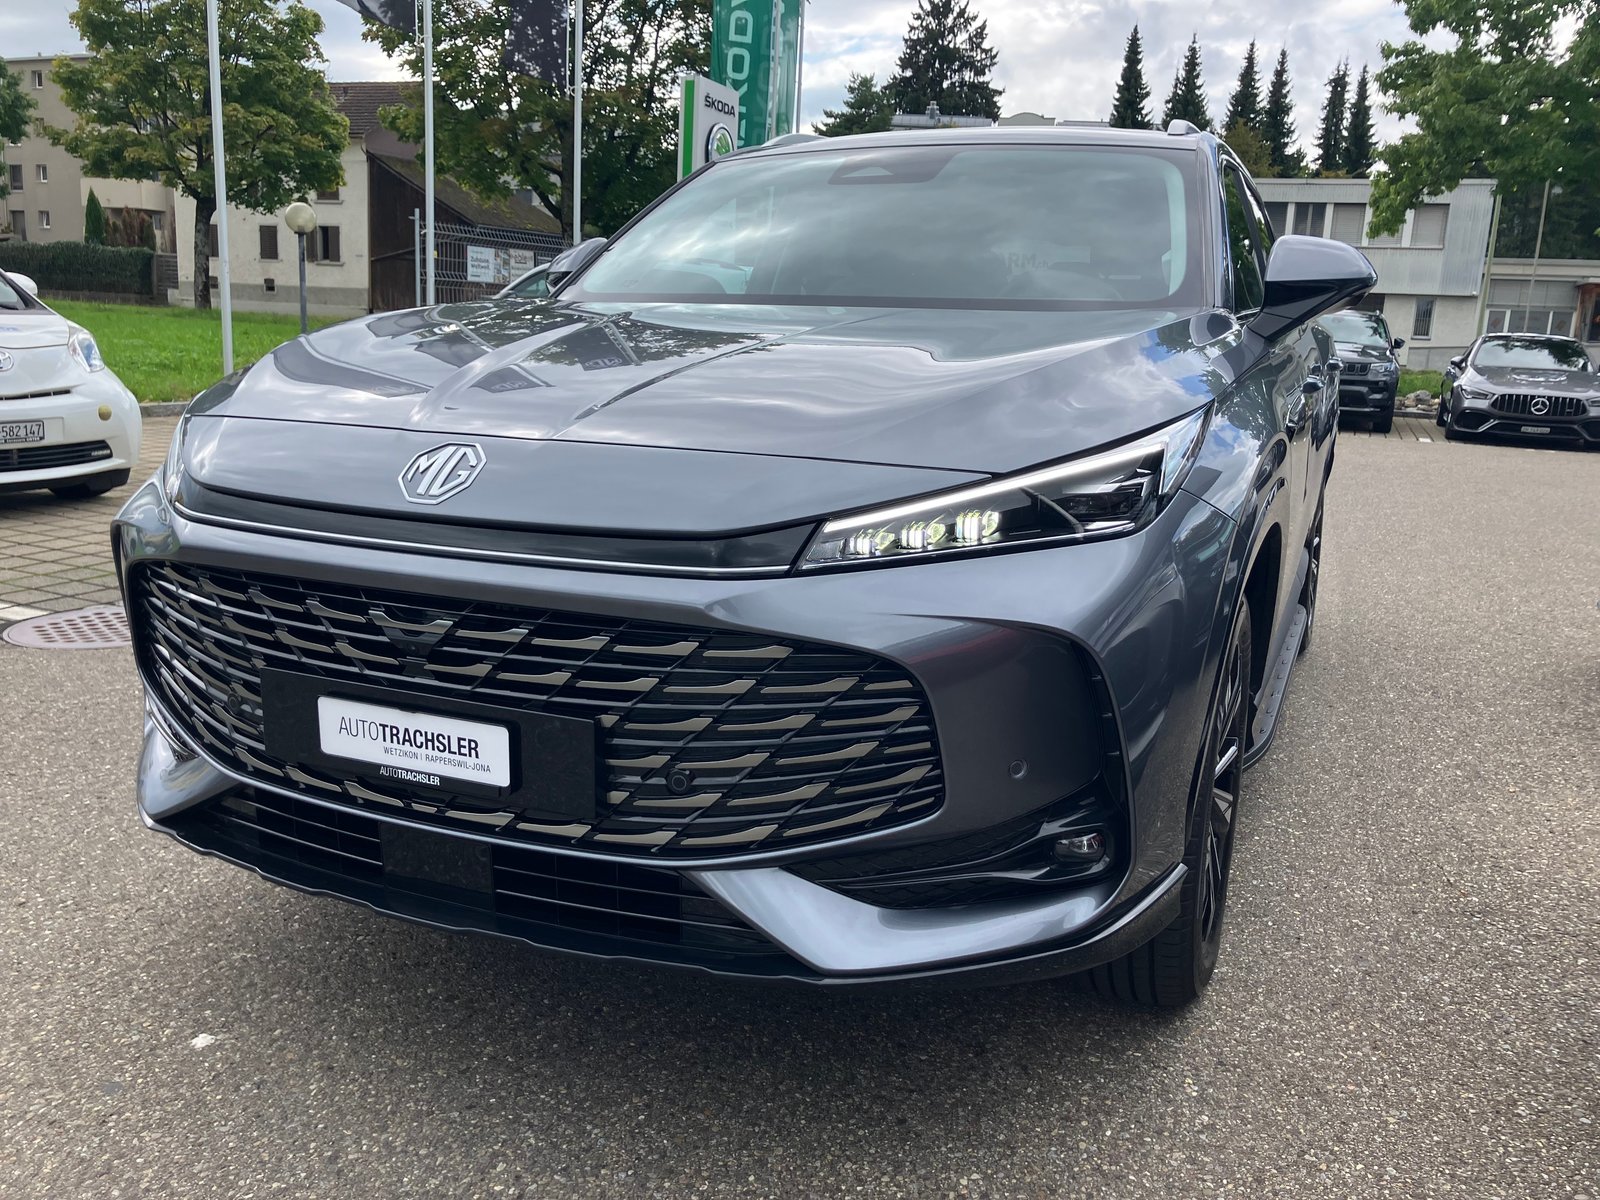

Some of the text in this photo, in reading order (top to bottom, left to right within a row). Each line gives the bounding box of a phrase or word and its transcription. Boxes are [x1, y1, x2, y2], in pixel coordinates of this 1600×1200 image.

[704, 92, 736, 118] ŠKODA
[407, 445, 479, 498] MG
[338, 716, 480, 759] AUTOTRACHSLER
[383, 746, 491, 773] WETZIKON RAPPERSWIL-JONA
[379, 765, 440, 786] AUTOTRACHSLER
